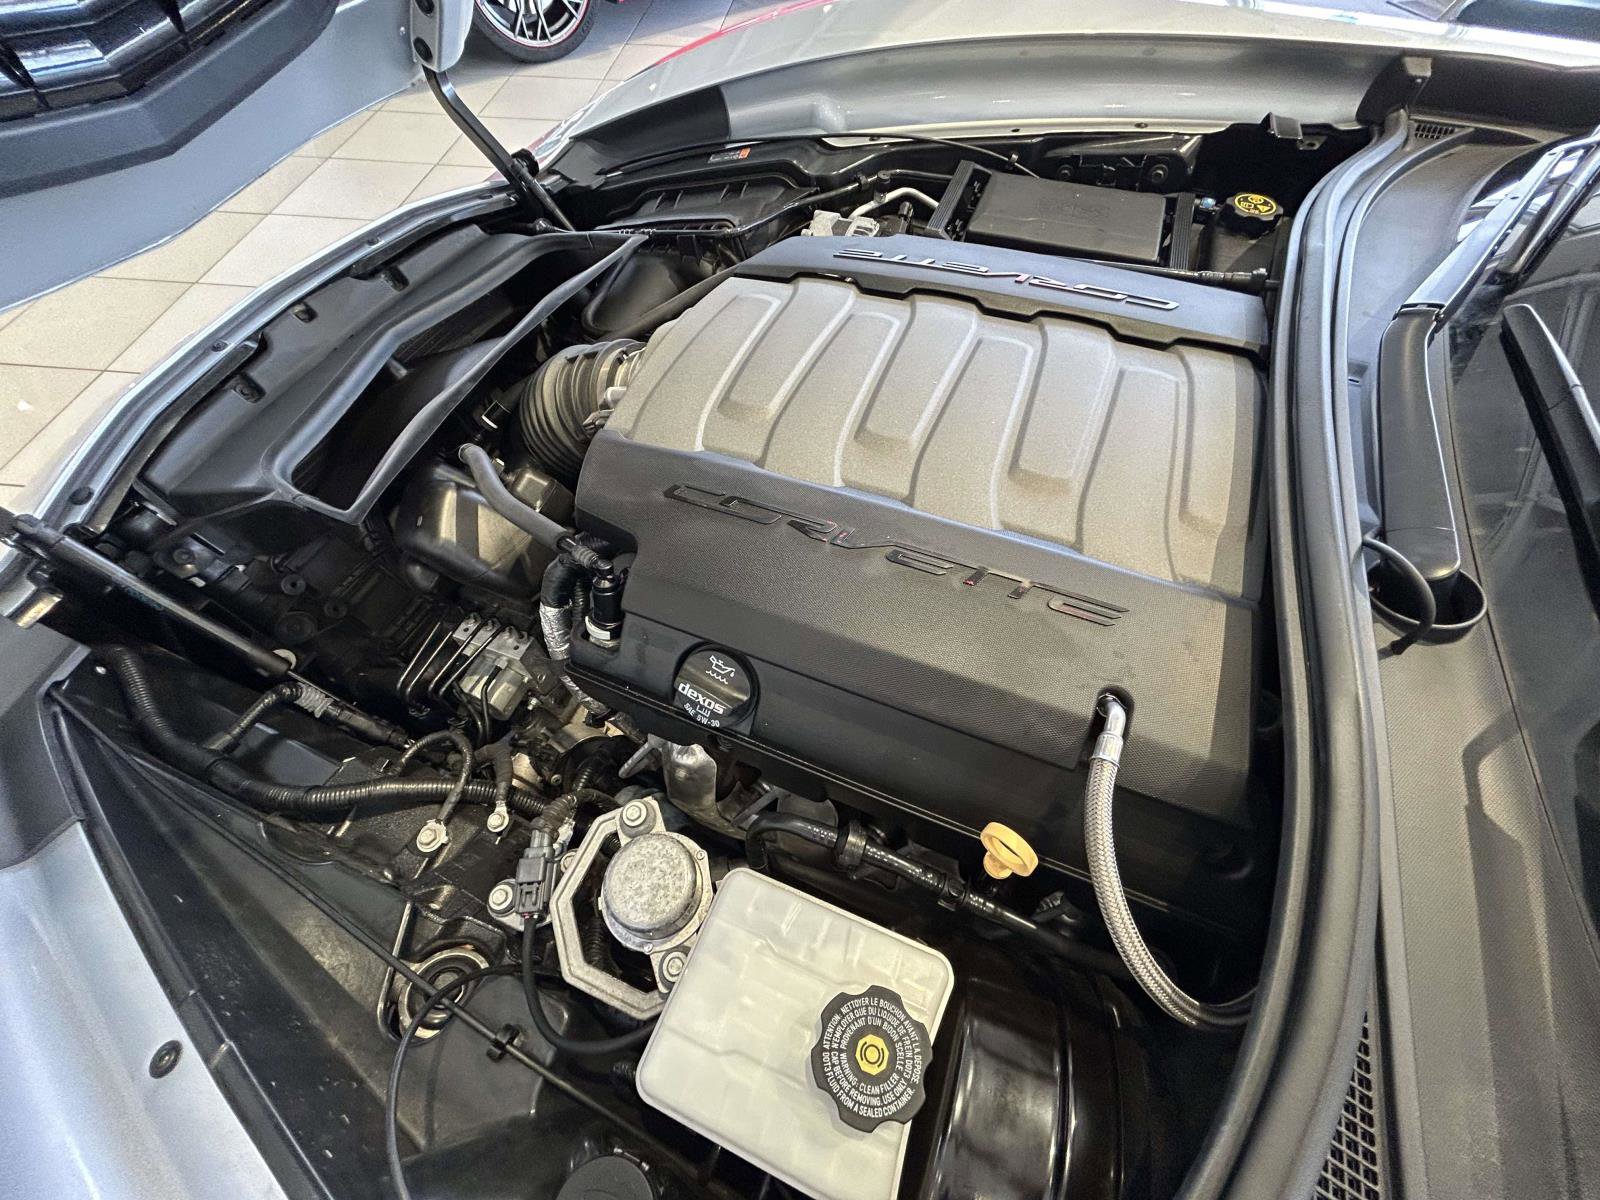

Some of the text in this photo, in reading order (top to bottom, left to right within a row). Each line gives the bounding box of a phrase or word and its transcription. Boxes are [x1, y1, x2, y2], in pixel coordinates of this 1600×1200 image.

[833, 248, 1180, 311] CORVETTE
[663, 484, 1130, 627] CORVETTE
[678, 682, 727, 715] dexos
[854, 1007, 868, 1018] QUE
[867, 1006, 877, 1016] DU
[877, 1008, 901, 1028] LIQUIDE
[840, 997, 870, 1015] NETTOYER
[870, 997, 879, 1006] LE
[879, 998, 907, 1022] BOUCHON
[903, 1020, 919, 1041] AVANT
[912, 1042, 921, 1054] LA
[840, 1017, 866, 1050] PROVENANT
[882, 1021, 900, 1042] BIDON
[896, 1025, 907, 1036] DE
[901, 1036, 913, 1058] FREIN
[822, 1051, 832, 1072] DOT3
[831, 1051, 840, 1065] CAP
[833, 1065, 852, 1093] BEFORE
[903, 1059, 913, 1079] DOT3
[825, 1071, 840, 1093] FLUID
[859, 1082, 880, 1095] CLEAN
[879, 1072, 900, 1093] FILLER
[893, 1077, 908, 1097] ONLY
[836, 1089, 855, 1110] FROM
[852, 1102, 860, 1113] A
[882, 1091, 896, 1105] USE
[858, 1105, 883, 1118] SEALED
